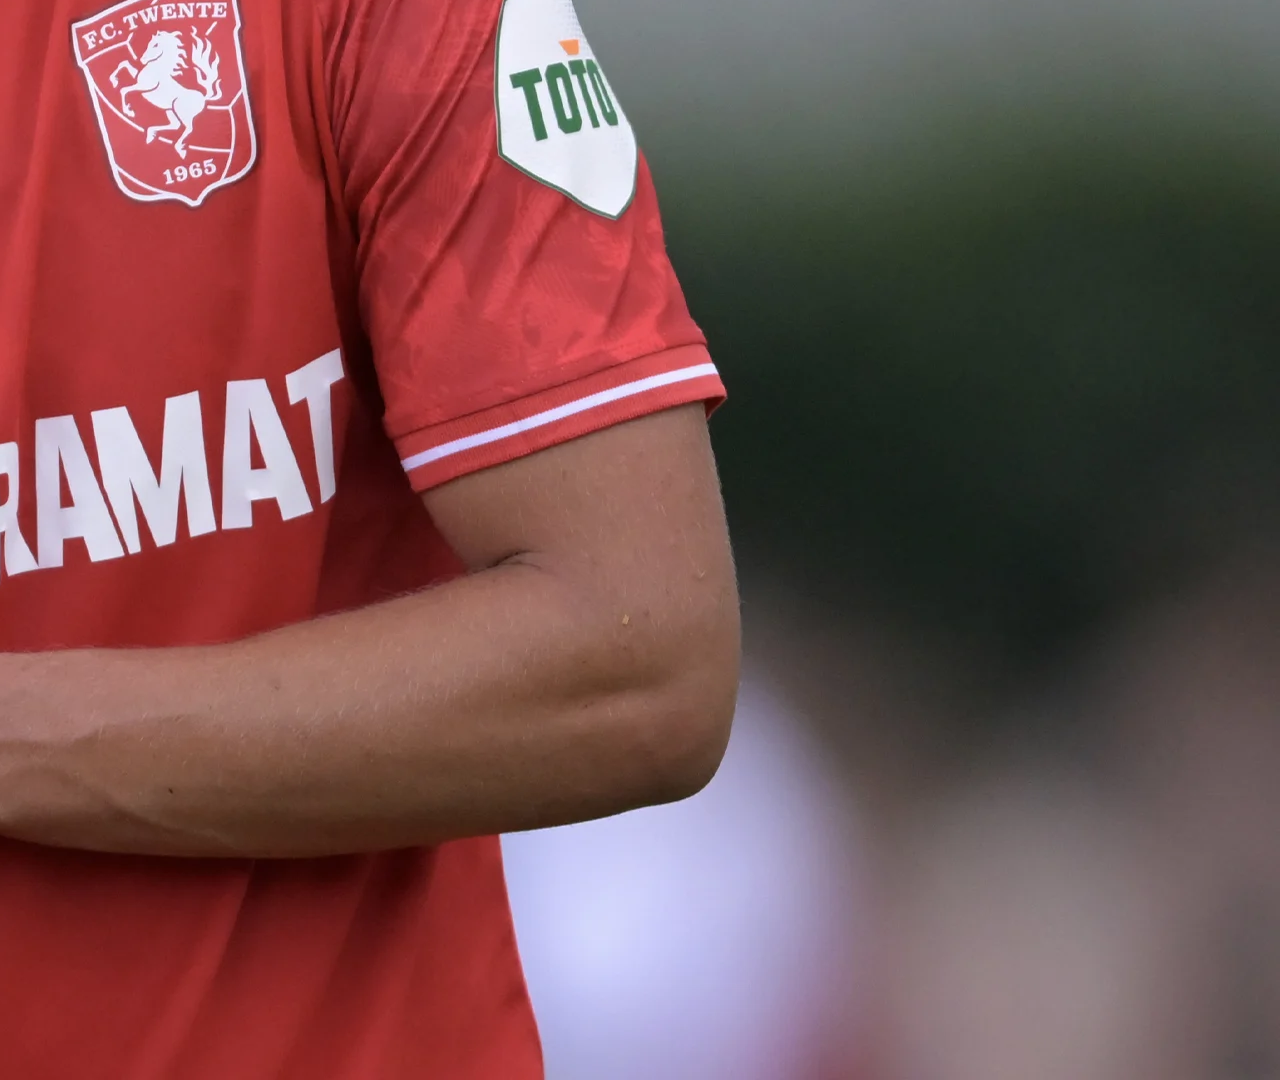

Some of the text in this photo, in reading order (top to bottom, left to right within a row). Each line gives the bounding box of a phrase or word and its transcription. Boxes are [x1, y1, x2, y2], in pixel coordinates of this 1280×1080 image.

[81, 1, 228, 50] F.C. TWENTE
[508, 58, 619, 142] TOTO
[163, 158, 217, 185] 1965
